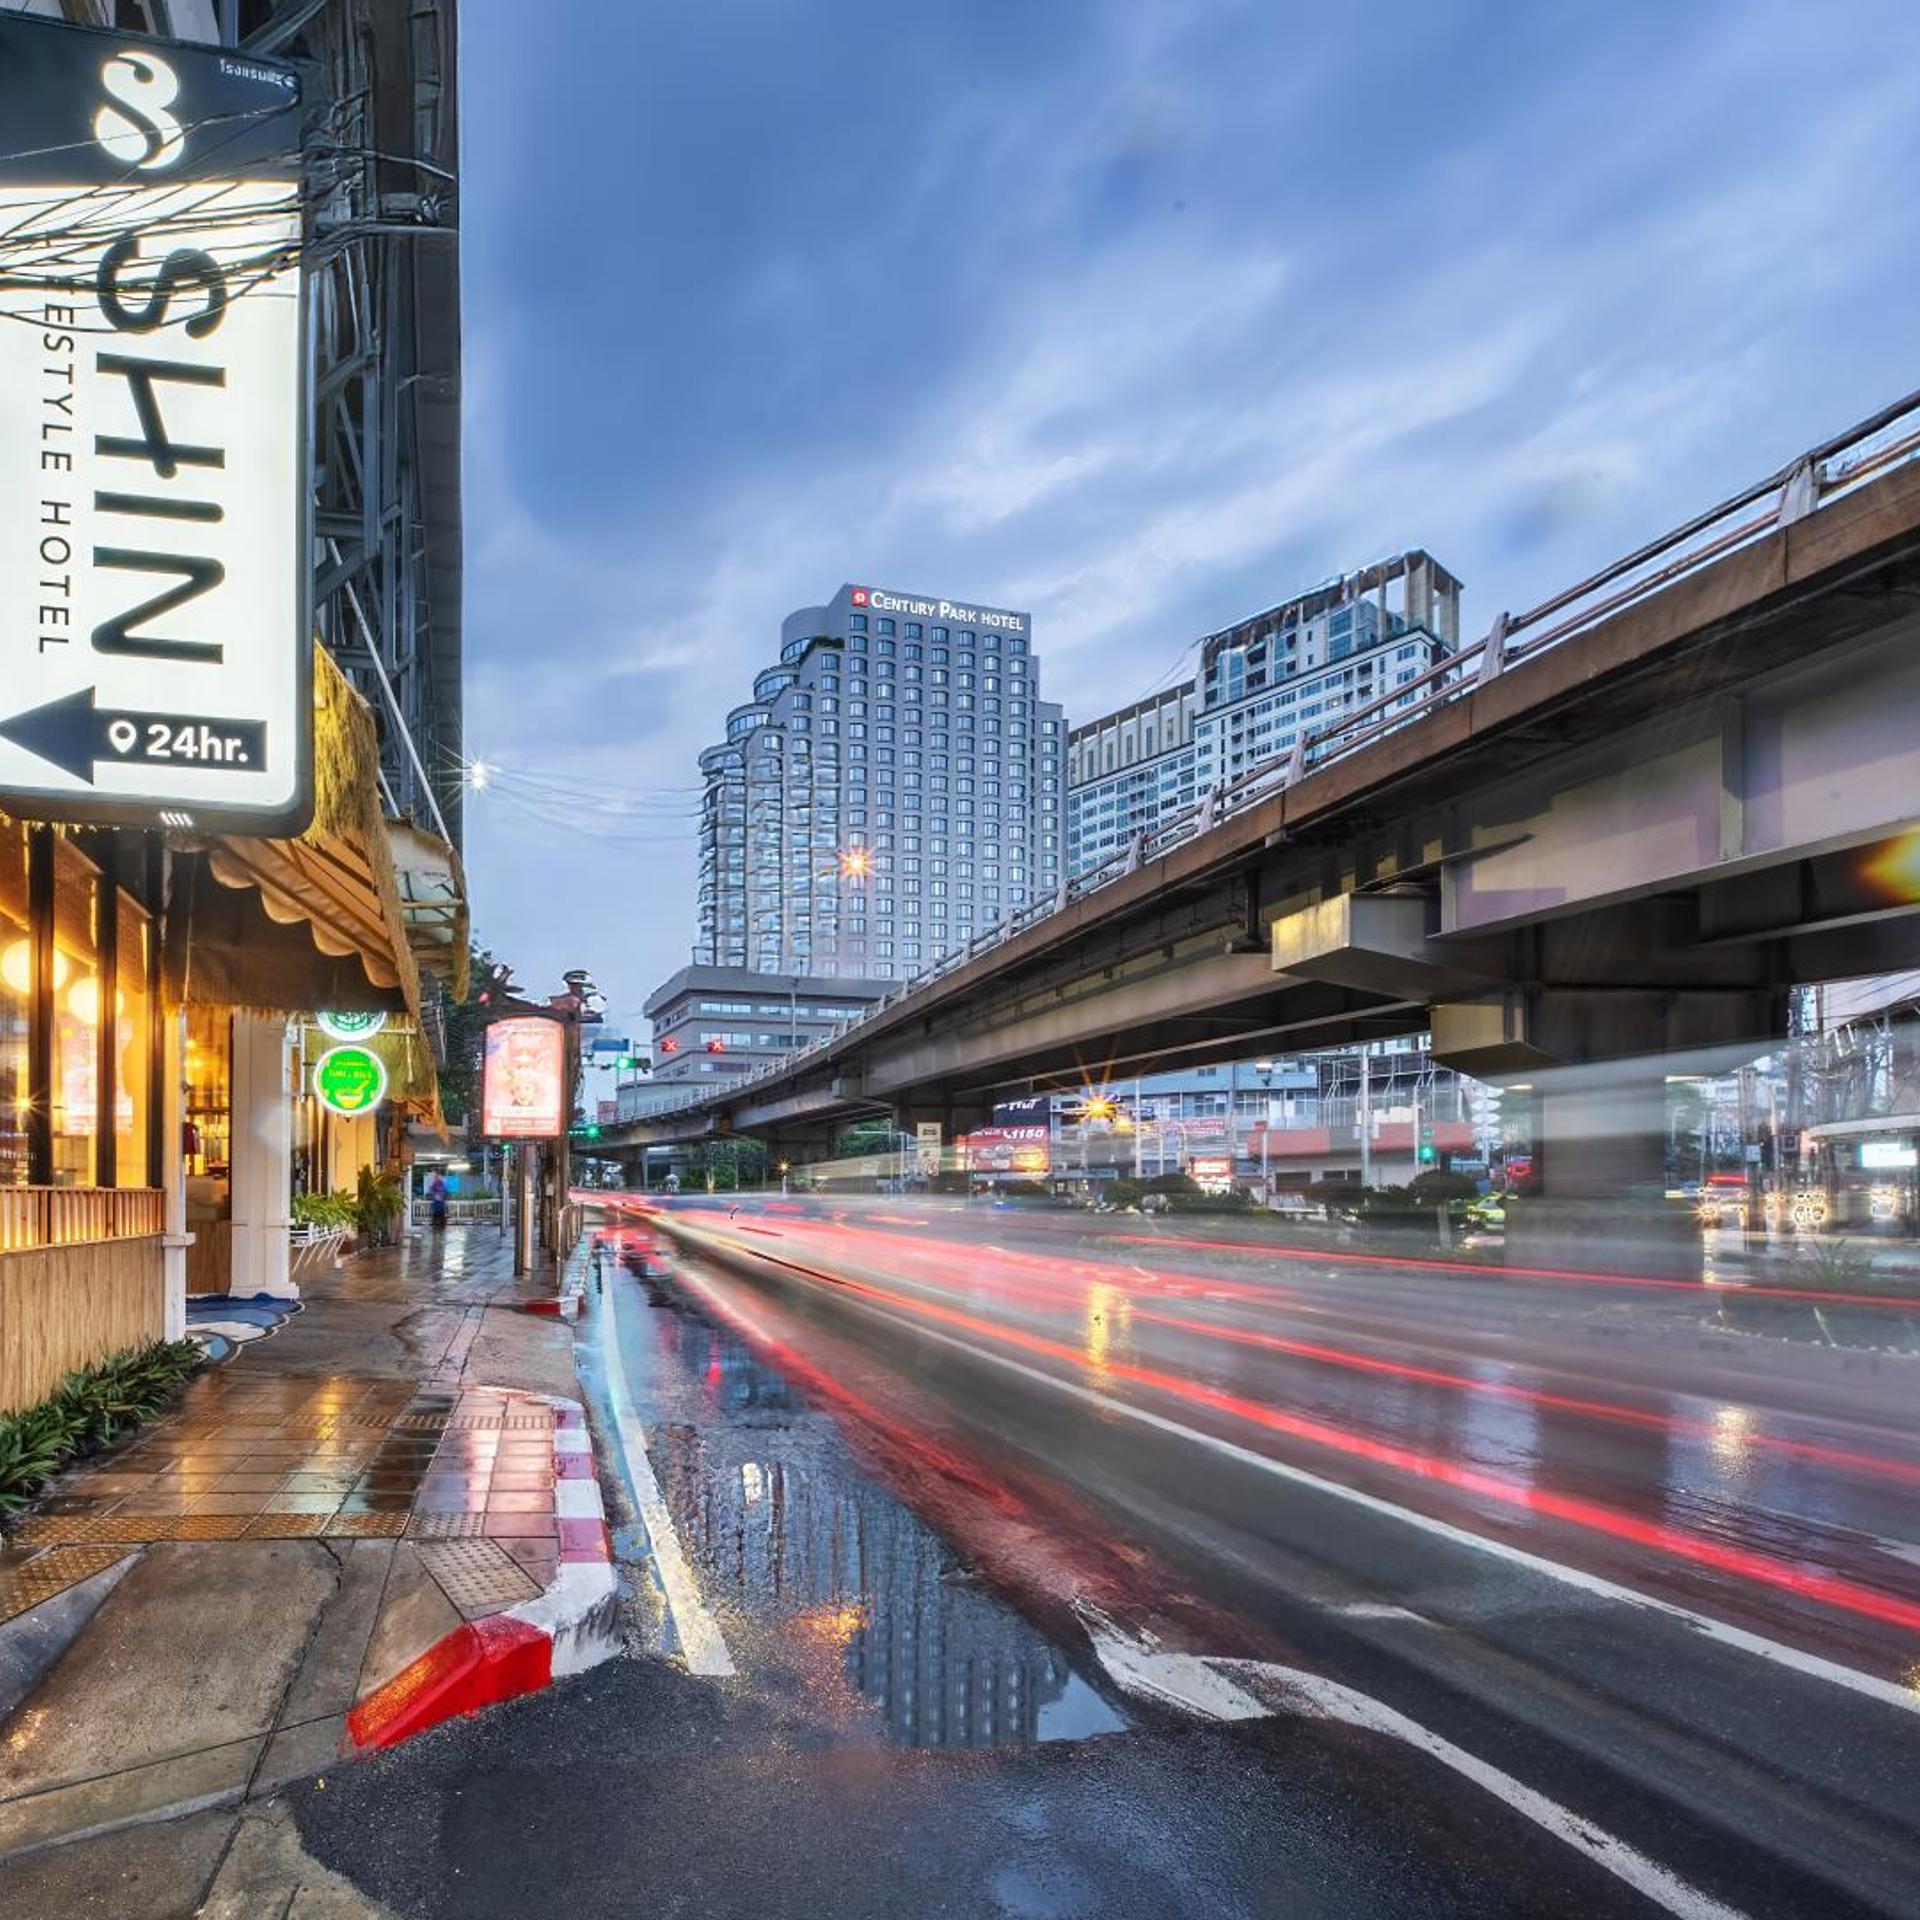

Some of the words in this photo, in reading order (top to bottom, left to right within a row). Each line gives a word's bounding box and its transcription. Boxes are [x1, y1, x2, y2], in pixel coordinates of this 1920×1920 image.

[38, 499, 72, 655] HOTEL
[980, 611, 1024, 631] HOTEL
[145, 723, 249, 763] 24hr.
